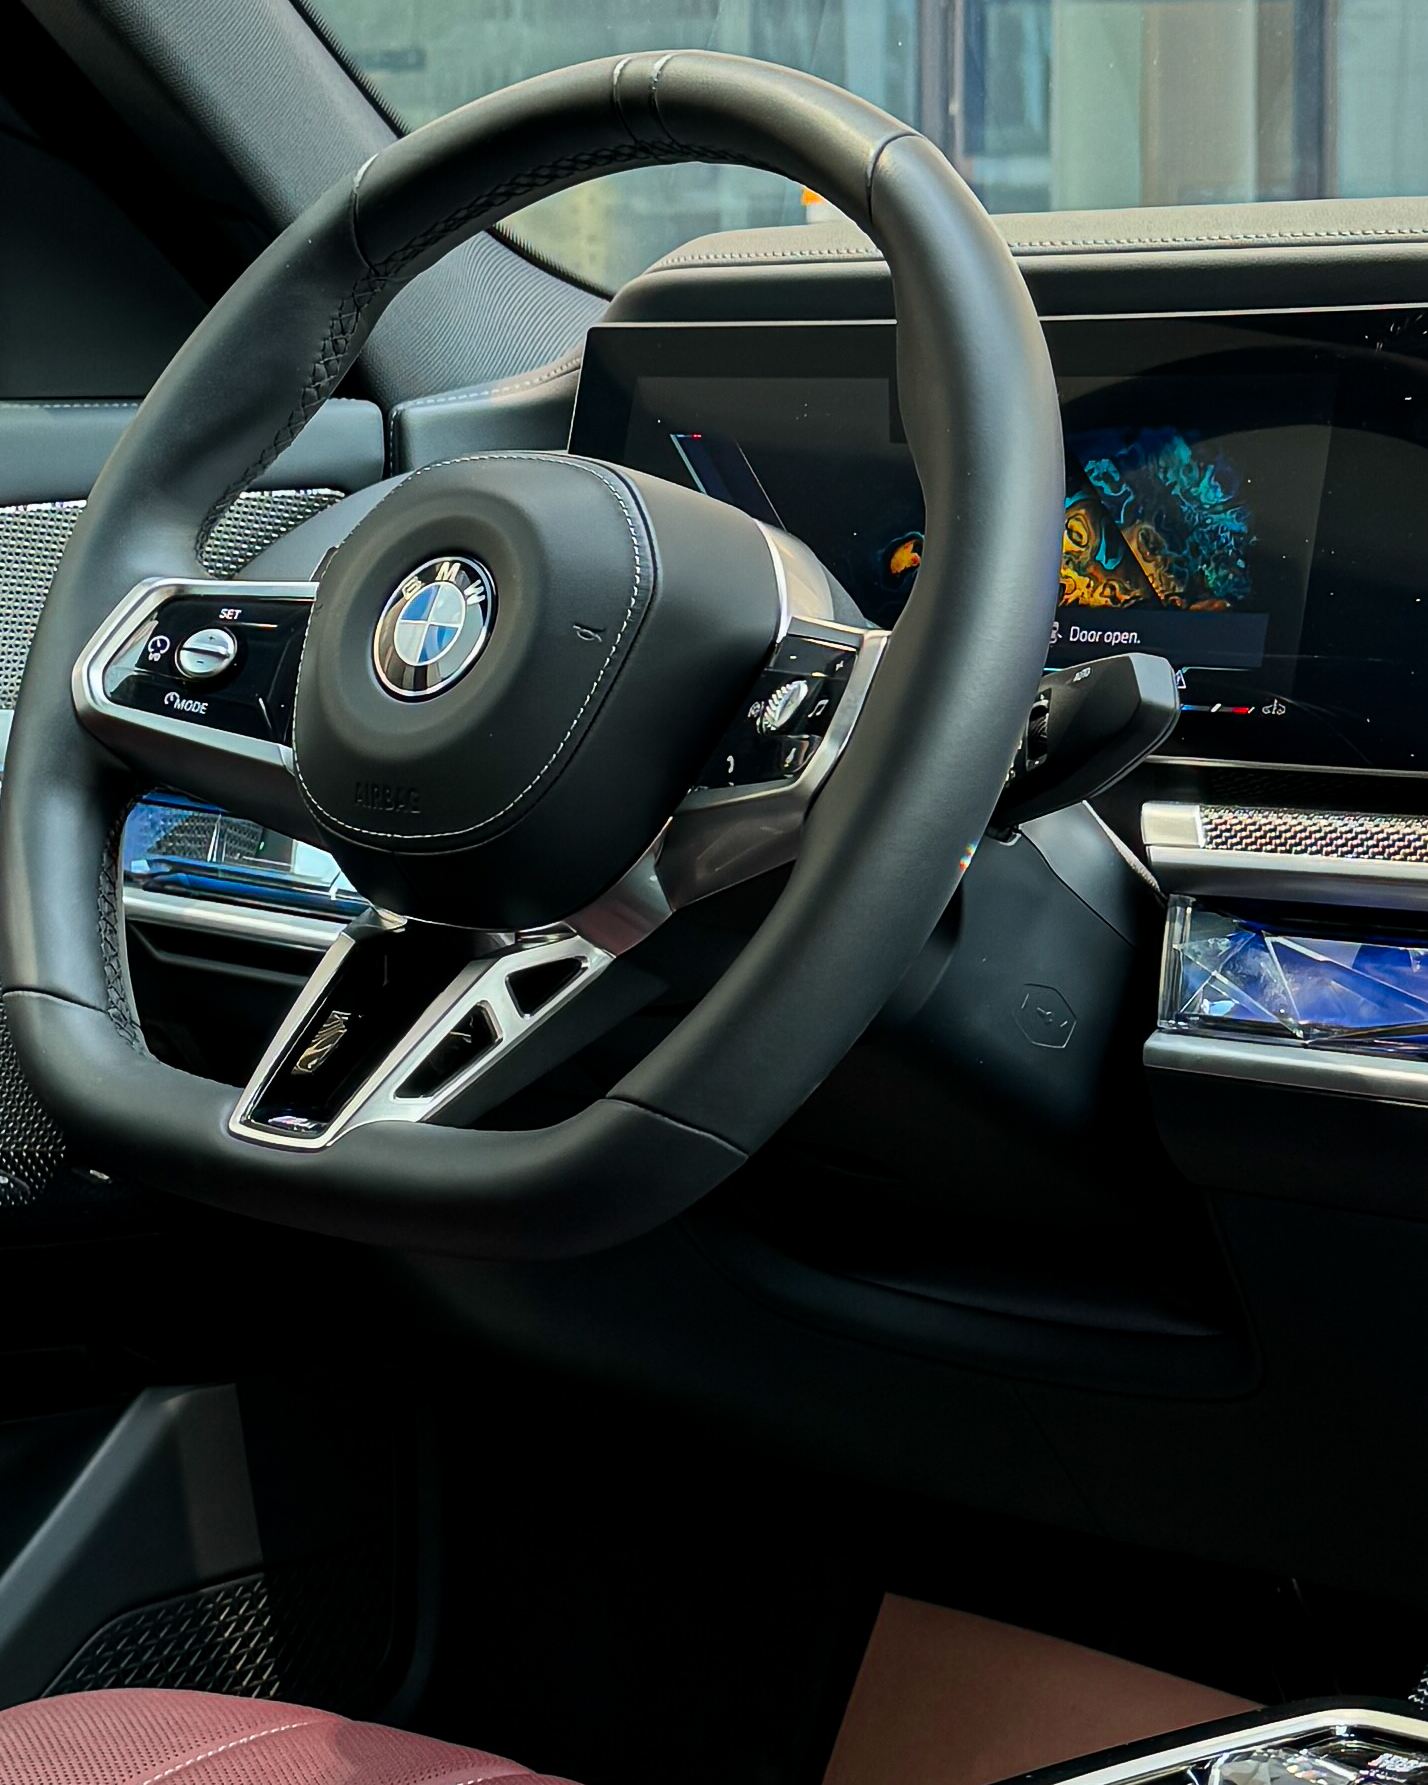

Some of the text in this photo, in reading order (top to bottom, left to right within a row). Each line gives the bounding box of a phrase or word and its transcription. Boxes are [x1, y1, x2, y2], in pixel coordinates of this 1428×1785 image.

[401, 561, 486, 606] BMW
[219, 608, 242, 620] SET
[1069, 626, 1141, 647] Door open.
[174, 699, 209, 715] MODE
